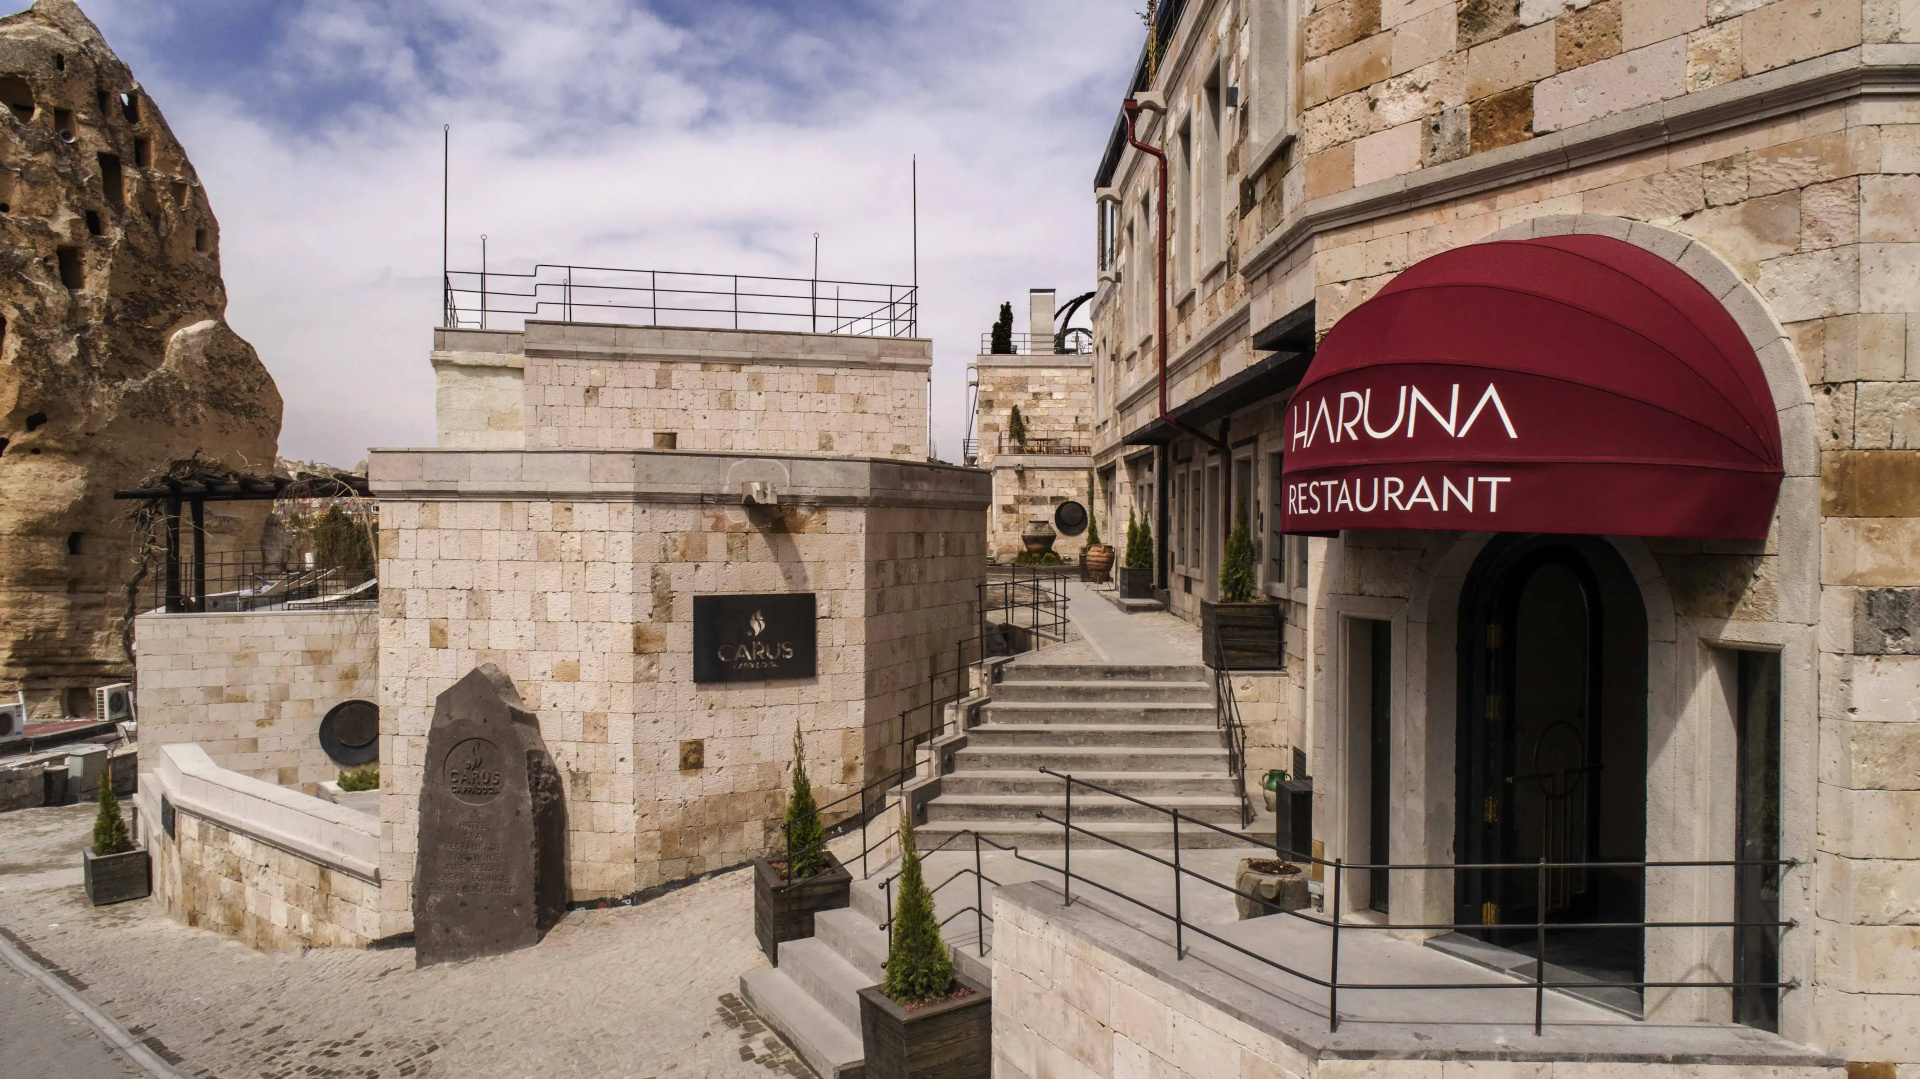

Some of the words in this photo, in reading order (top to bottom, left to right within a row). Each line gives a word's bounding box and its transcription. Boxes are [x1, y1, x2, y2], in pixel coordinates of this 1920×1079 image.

[1292, 382, 1518, 452] HARUNA
[1288, 475, 1511, 515] RESTAURANT
[717, 641, 794, 662] CARUS
[450, 769, 501, 785] CARUS
[451, 785, 501, 796] CAPPADOCIA
[460, 821, 487, 831] HOTEL
[445, 842, 502, 852] RESTAURANT
[470, 864, 503, 874] CELLAR
[438, 873, 465, 883] CIGAR
[471, 874, 507, 884] LOUNGE
[492, 886, 514, 896] HALL
